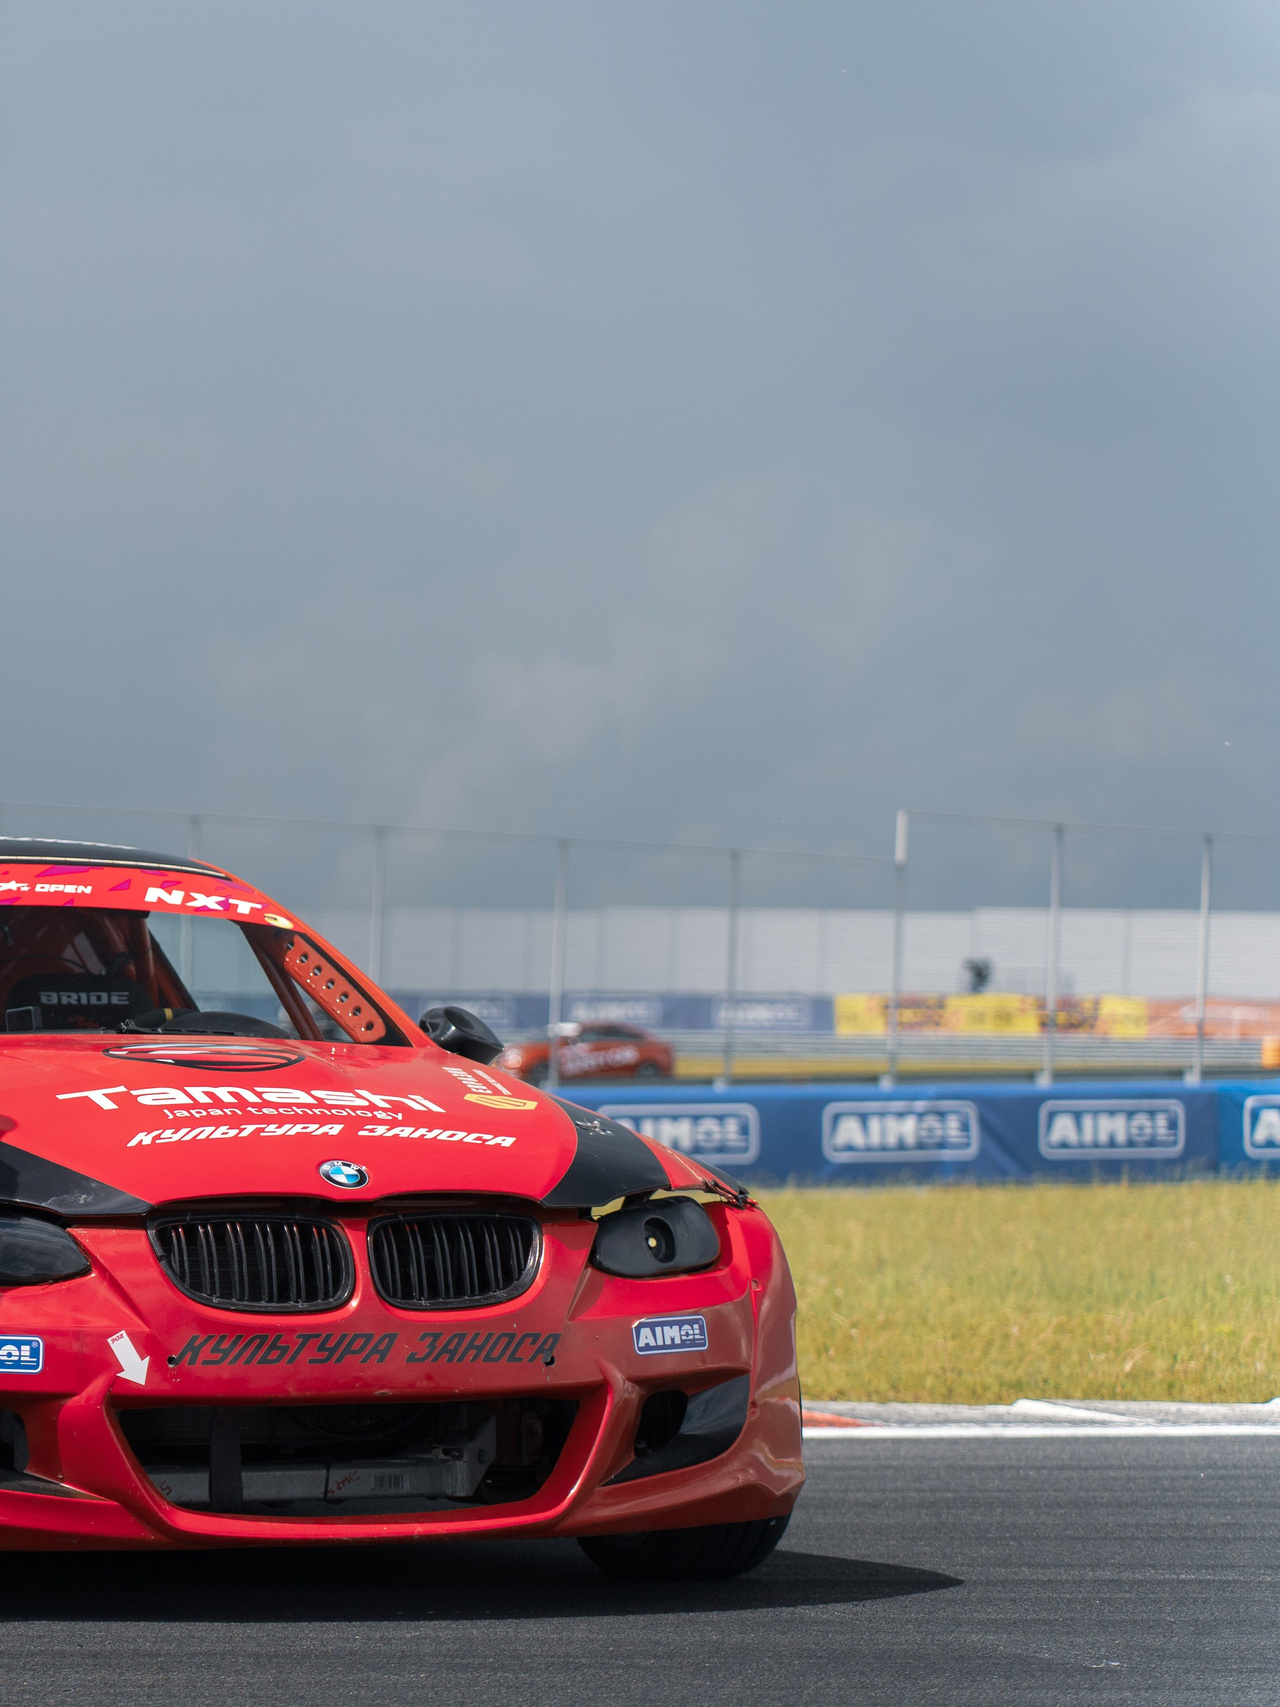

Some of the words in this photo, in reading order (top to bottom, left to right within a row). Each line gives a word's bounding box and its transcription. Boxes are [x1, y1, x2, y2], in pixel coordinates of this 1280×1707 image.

[34, 883, 93, 894] OPEN
[144, 887, 263, 915] NXT
[38, 991, 130, 1006] BRIDE
[56, 1085, 447, 1113] Tamashi
[246, 1106, 403, 1121] technology
[127, 1124, 345, 1147] КУЛЬТУРА
[357, 1124, 517, 1147] ЗАНОСА
[831, 1112, 970, 1149] AIMOL
[1047, 1111, 1177, 1147] AIMOL
[638, 1322, 706, 1347] AIMOL
[175, 1333, 399, 1366] КУЛЬТУРА
[406, 1332, 562, 1364] ЗАНОСА
